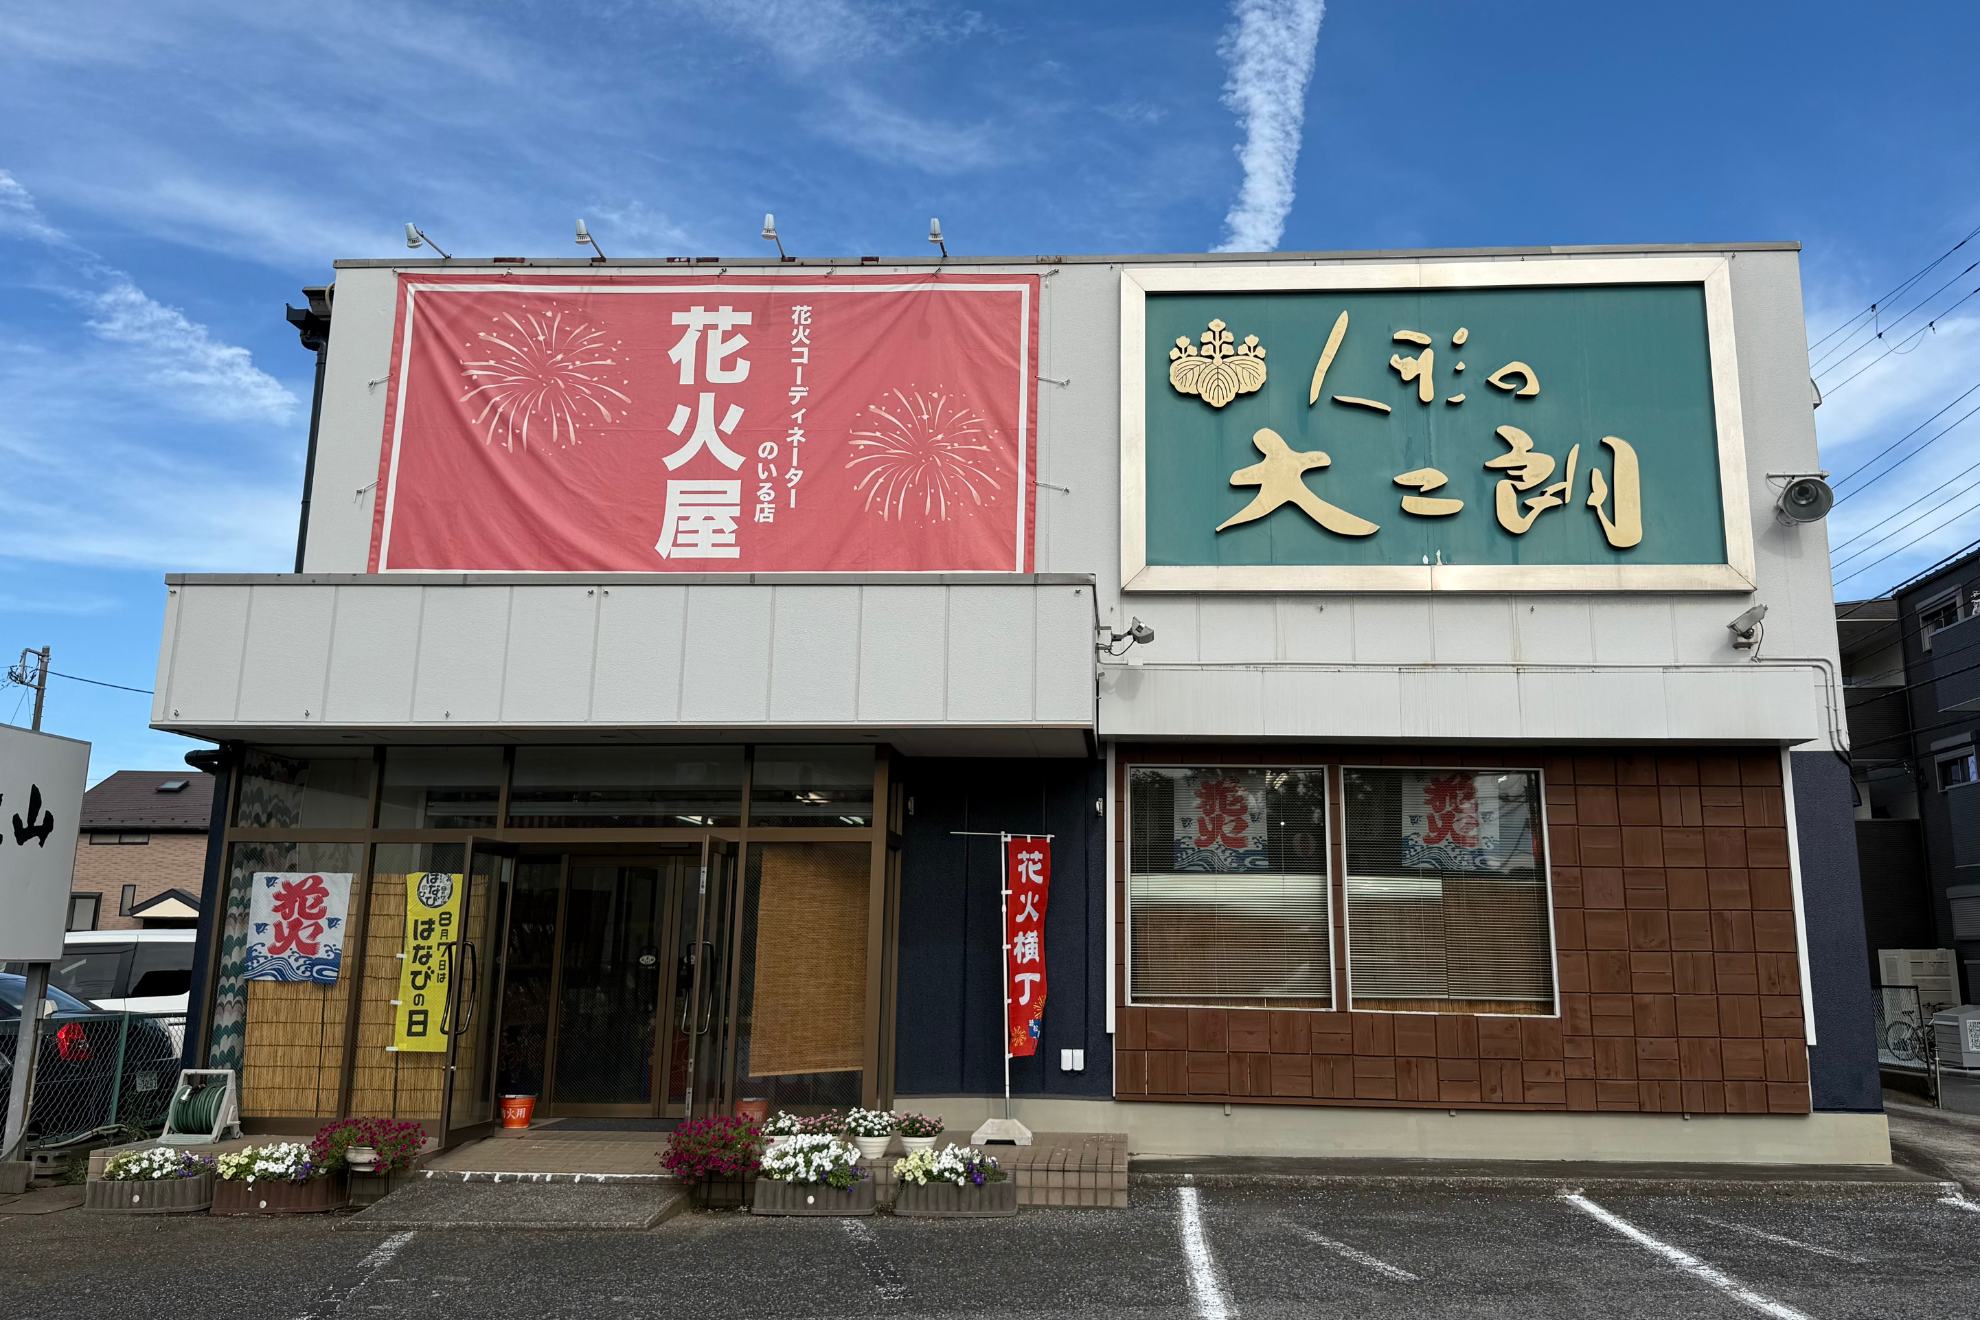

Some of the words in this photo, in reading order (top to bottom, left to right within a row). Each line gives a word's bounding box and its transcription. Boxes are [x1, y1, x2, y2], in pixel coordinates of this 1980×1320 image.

[654, 305, 752, 561] 花火屋
[784, 304, 813, 509] 花火コーディネーター
[753, 441, 779, 524] のいる店
[0, 783, 54, 848] 山
[267, 874, 330, 957] 花火
[1013, 850, 1044, 1006] 花火横丁
[406, 917, 436, 1038] はなびの日
